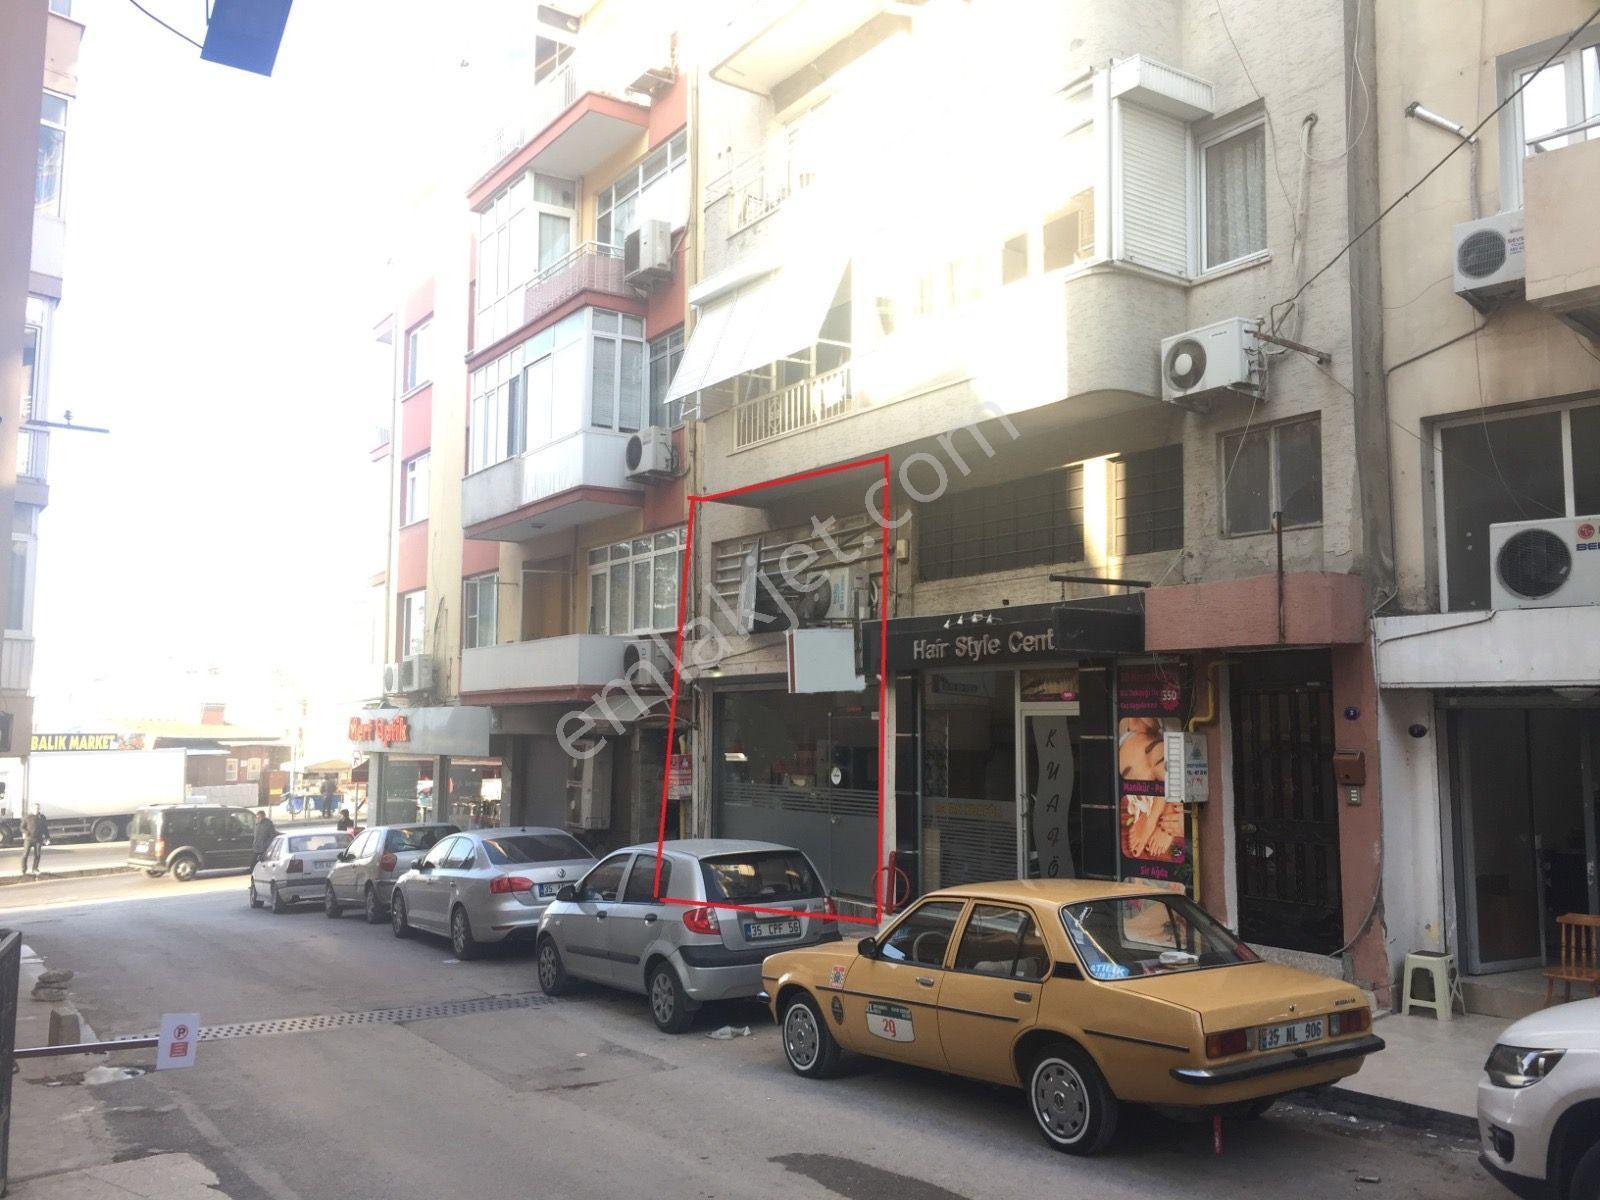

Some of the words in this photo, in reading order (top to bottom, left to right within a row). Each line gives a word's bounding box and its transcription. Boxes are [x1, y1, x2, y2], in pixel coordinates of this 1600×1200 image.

[913, 638, 949, 660] Hair
[955, 633, 1000, 661] Style
[31, 735, 67, 751] BALIK
[68, 734, 117, 750] MARKET
[752, 925, 762, 937] 35
[1268, 1028, 1280, 1046] 35
[1286, 1026, 1298, 1042] NL
[1305, 1021, 1322, 1039] 906
